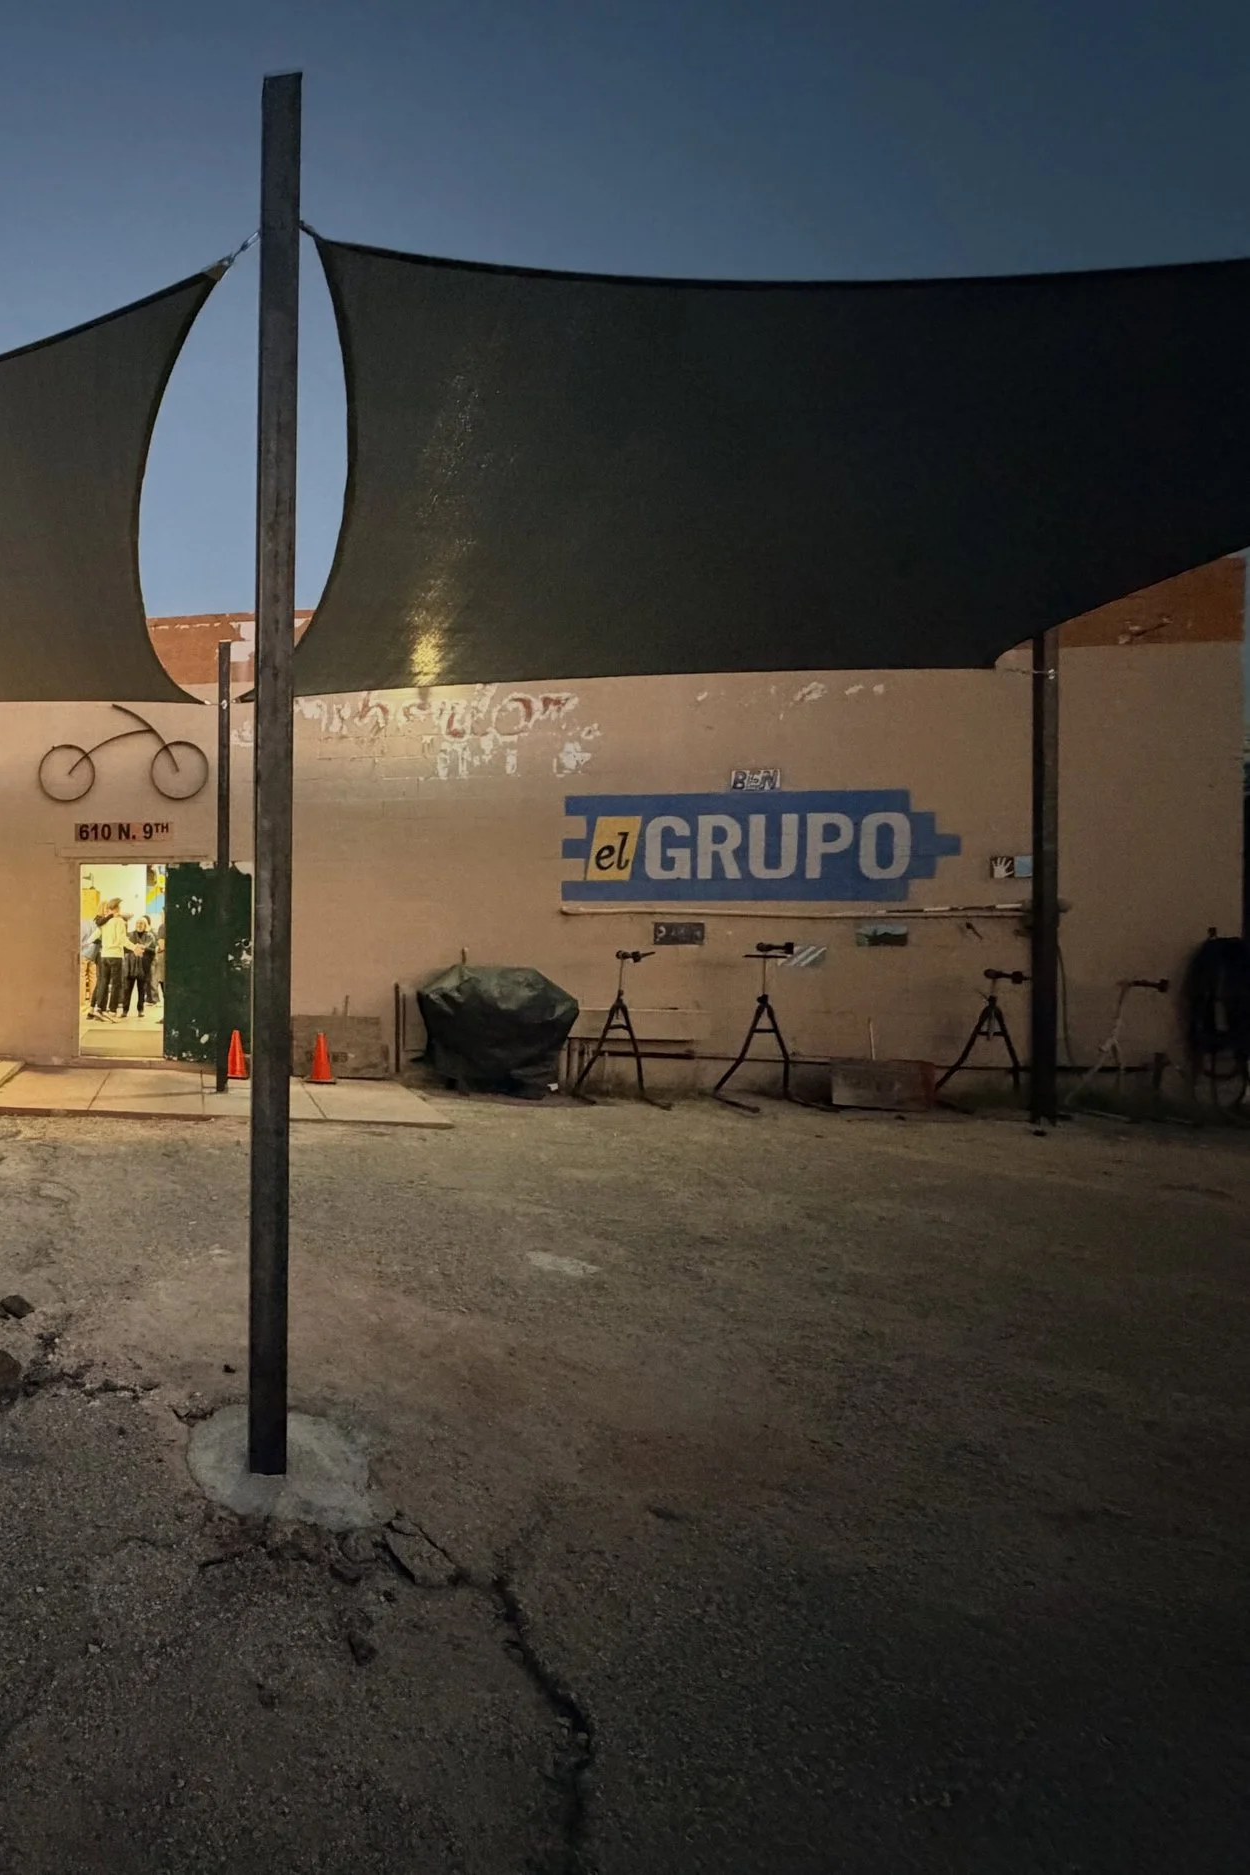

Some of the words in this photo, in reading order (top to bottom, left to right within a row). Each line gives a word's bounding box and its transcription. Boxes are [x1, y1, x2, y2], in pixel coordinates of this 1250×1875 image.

[79, 823, 111, 841] 610
[118, 823, 136, 841] N.
[143, 823, 169, 840] 9TH
[595, 831, 630, 871] el
[644, 812, 912, 880] GRUPO
